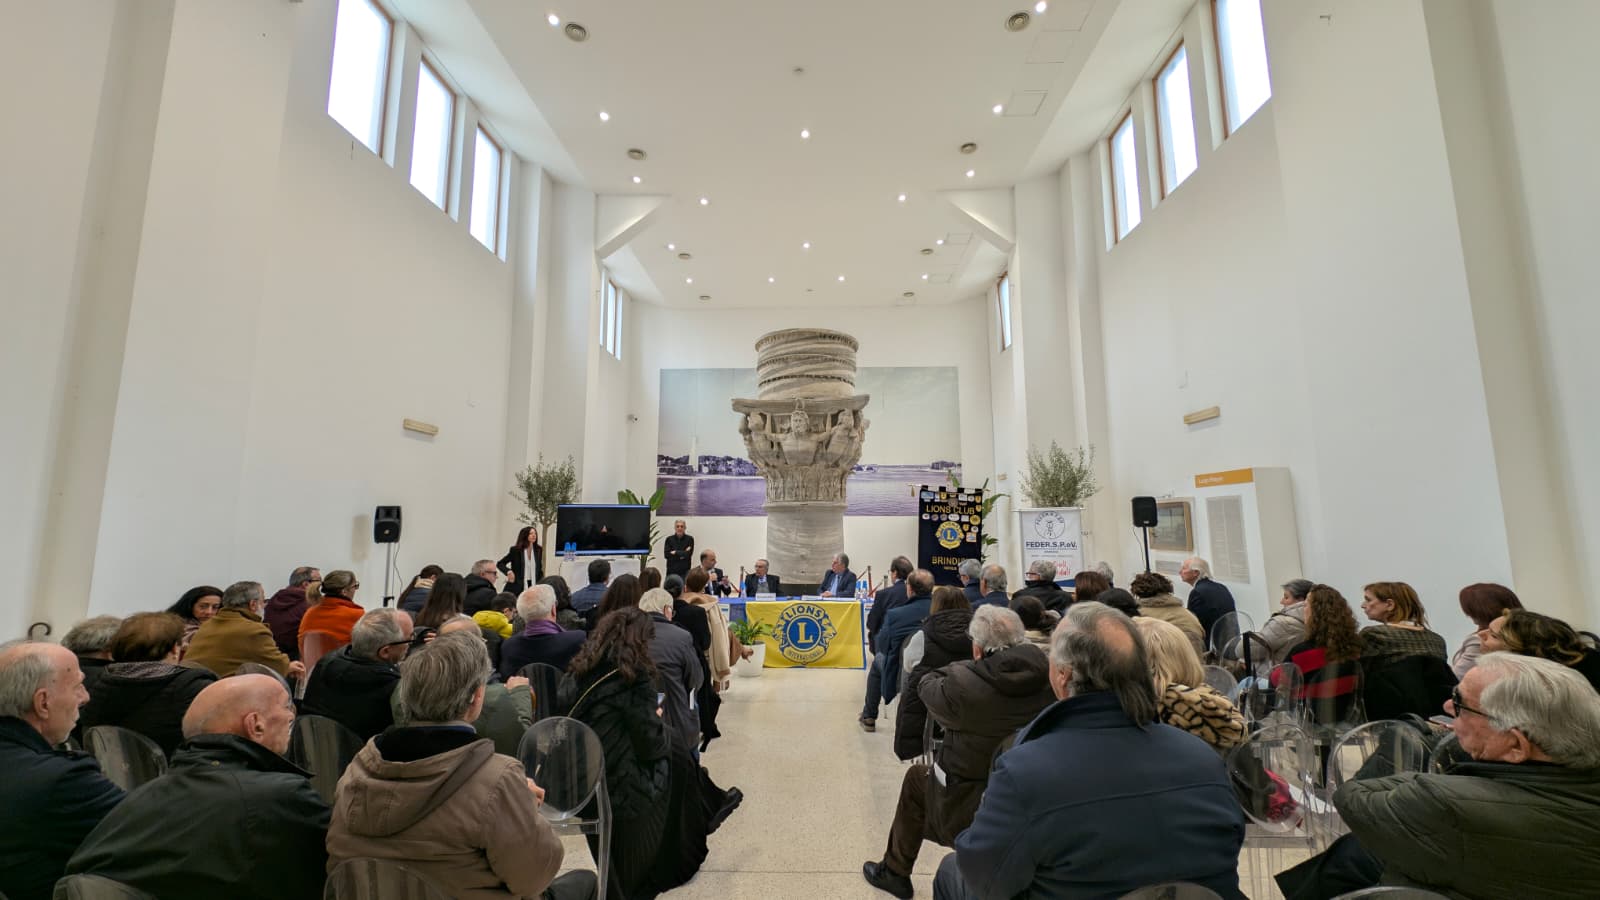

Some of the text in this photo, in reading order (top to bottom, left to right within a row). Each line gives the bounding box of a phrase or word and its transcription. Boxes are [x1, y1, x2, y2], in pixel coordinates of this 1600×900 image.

[926, 504, 975, 514] LIONS CLUB
[946, 530, 954, 540] L
[931, 556, 966, 566] BRINDI
[786, 605, 821, 618] LIONS
[798, 622, 813, 643] L
